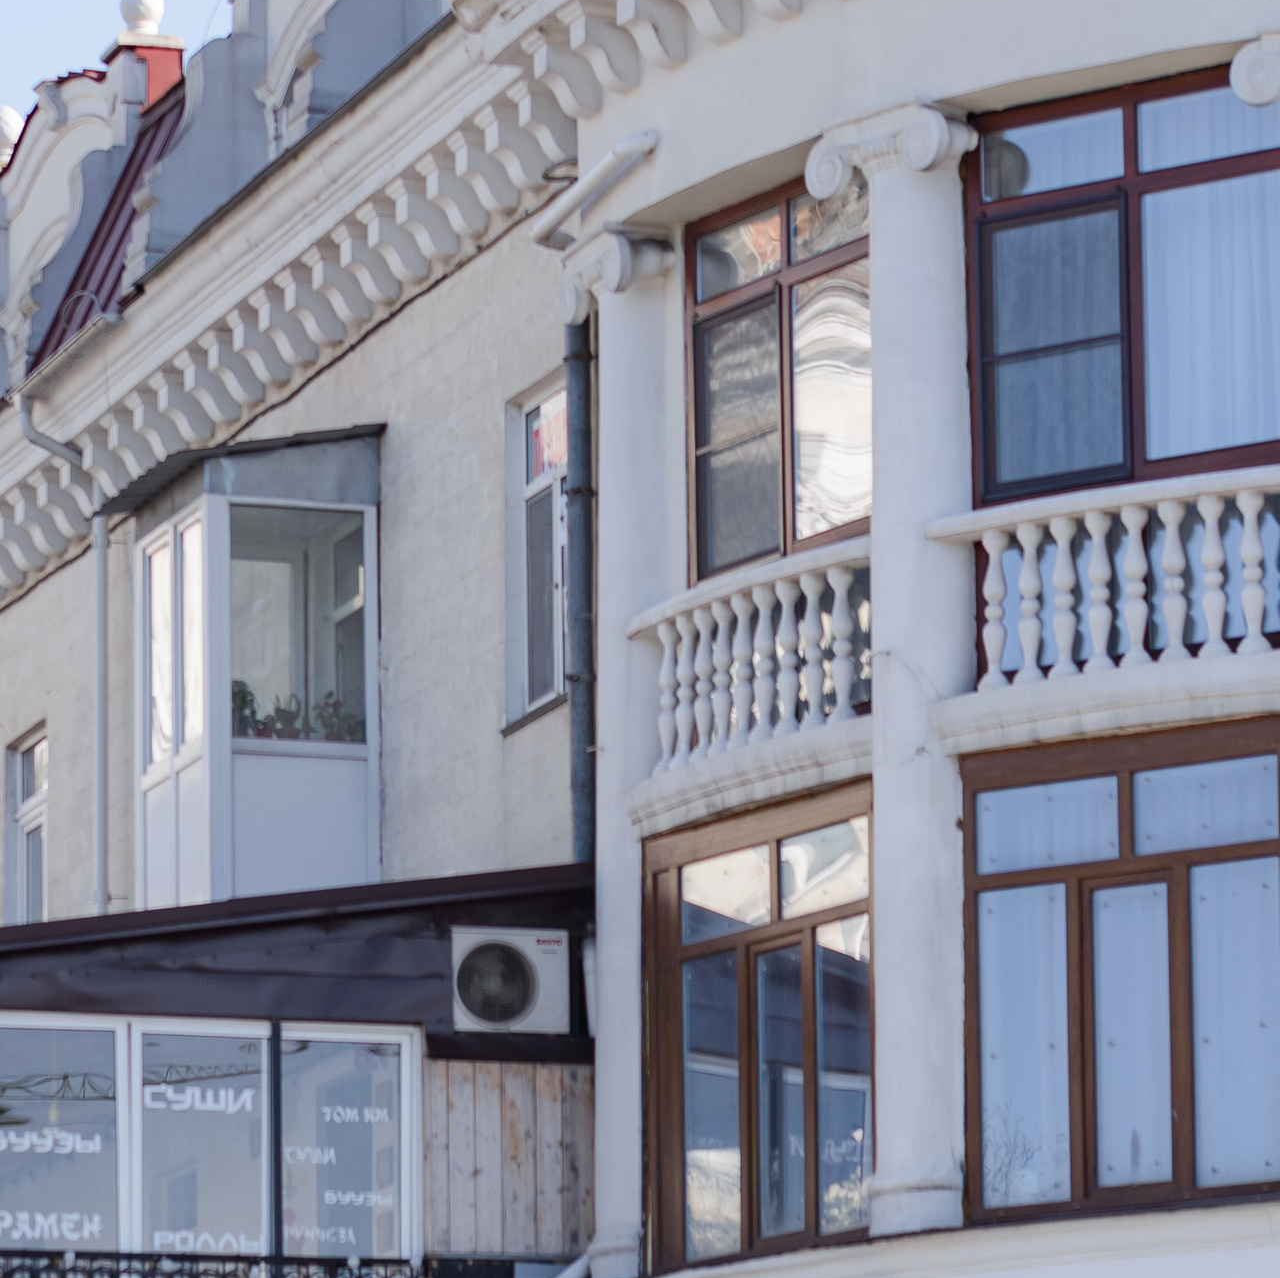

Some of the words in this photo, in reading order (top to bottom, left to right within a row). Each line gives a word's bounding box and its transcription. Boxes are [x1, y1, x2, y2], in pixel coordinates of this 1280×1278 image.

[143, 1084, 255, 1114] СУШИ
[321, 1105, 359, 1123] ТОМ
[324, 1189, 393, 1206] БУУЗЫ
[153, 1229, 266, 1253] РОЛЛЫ
